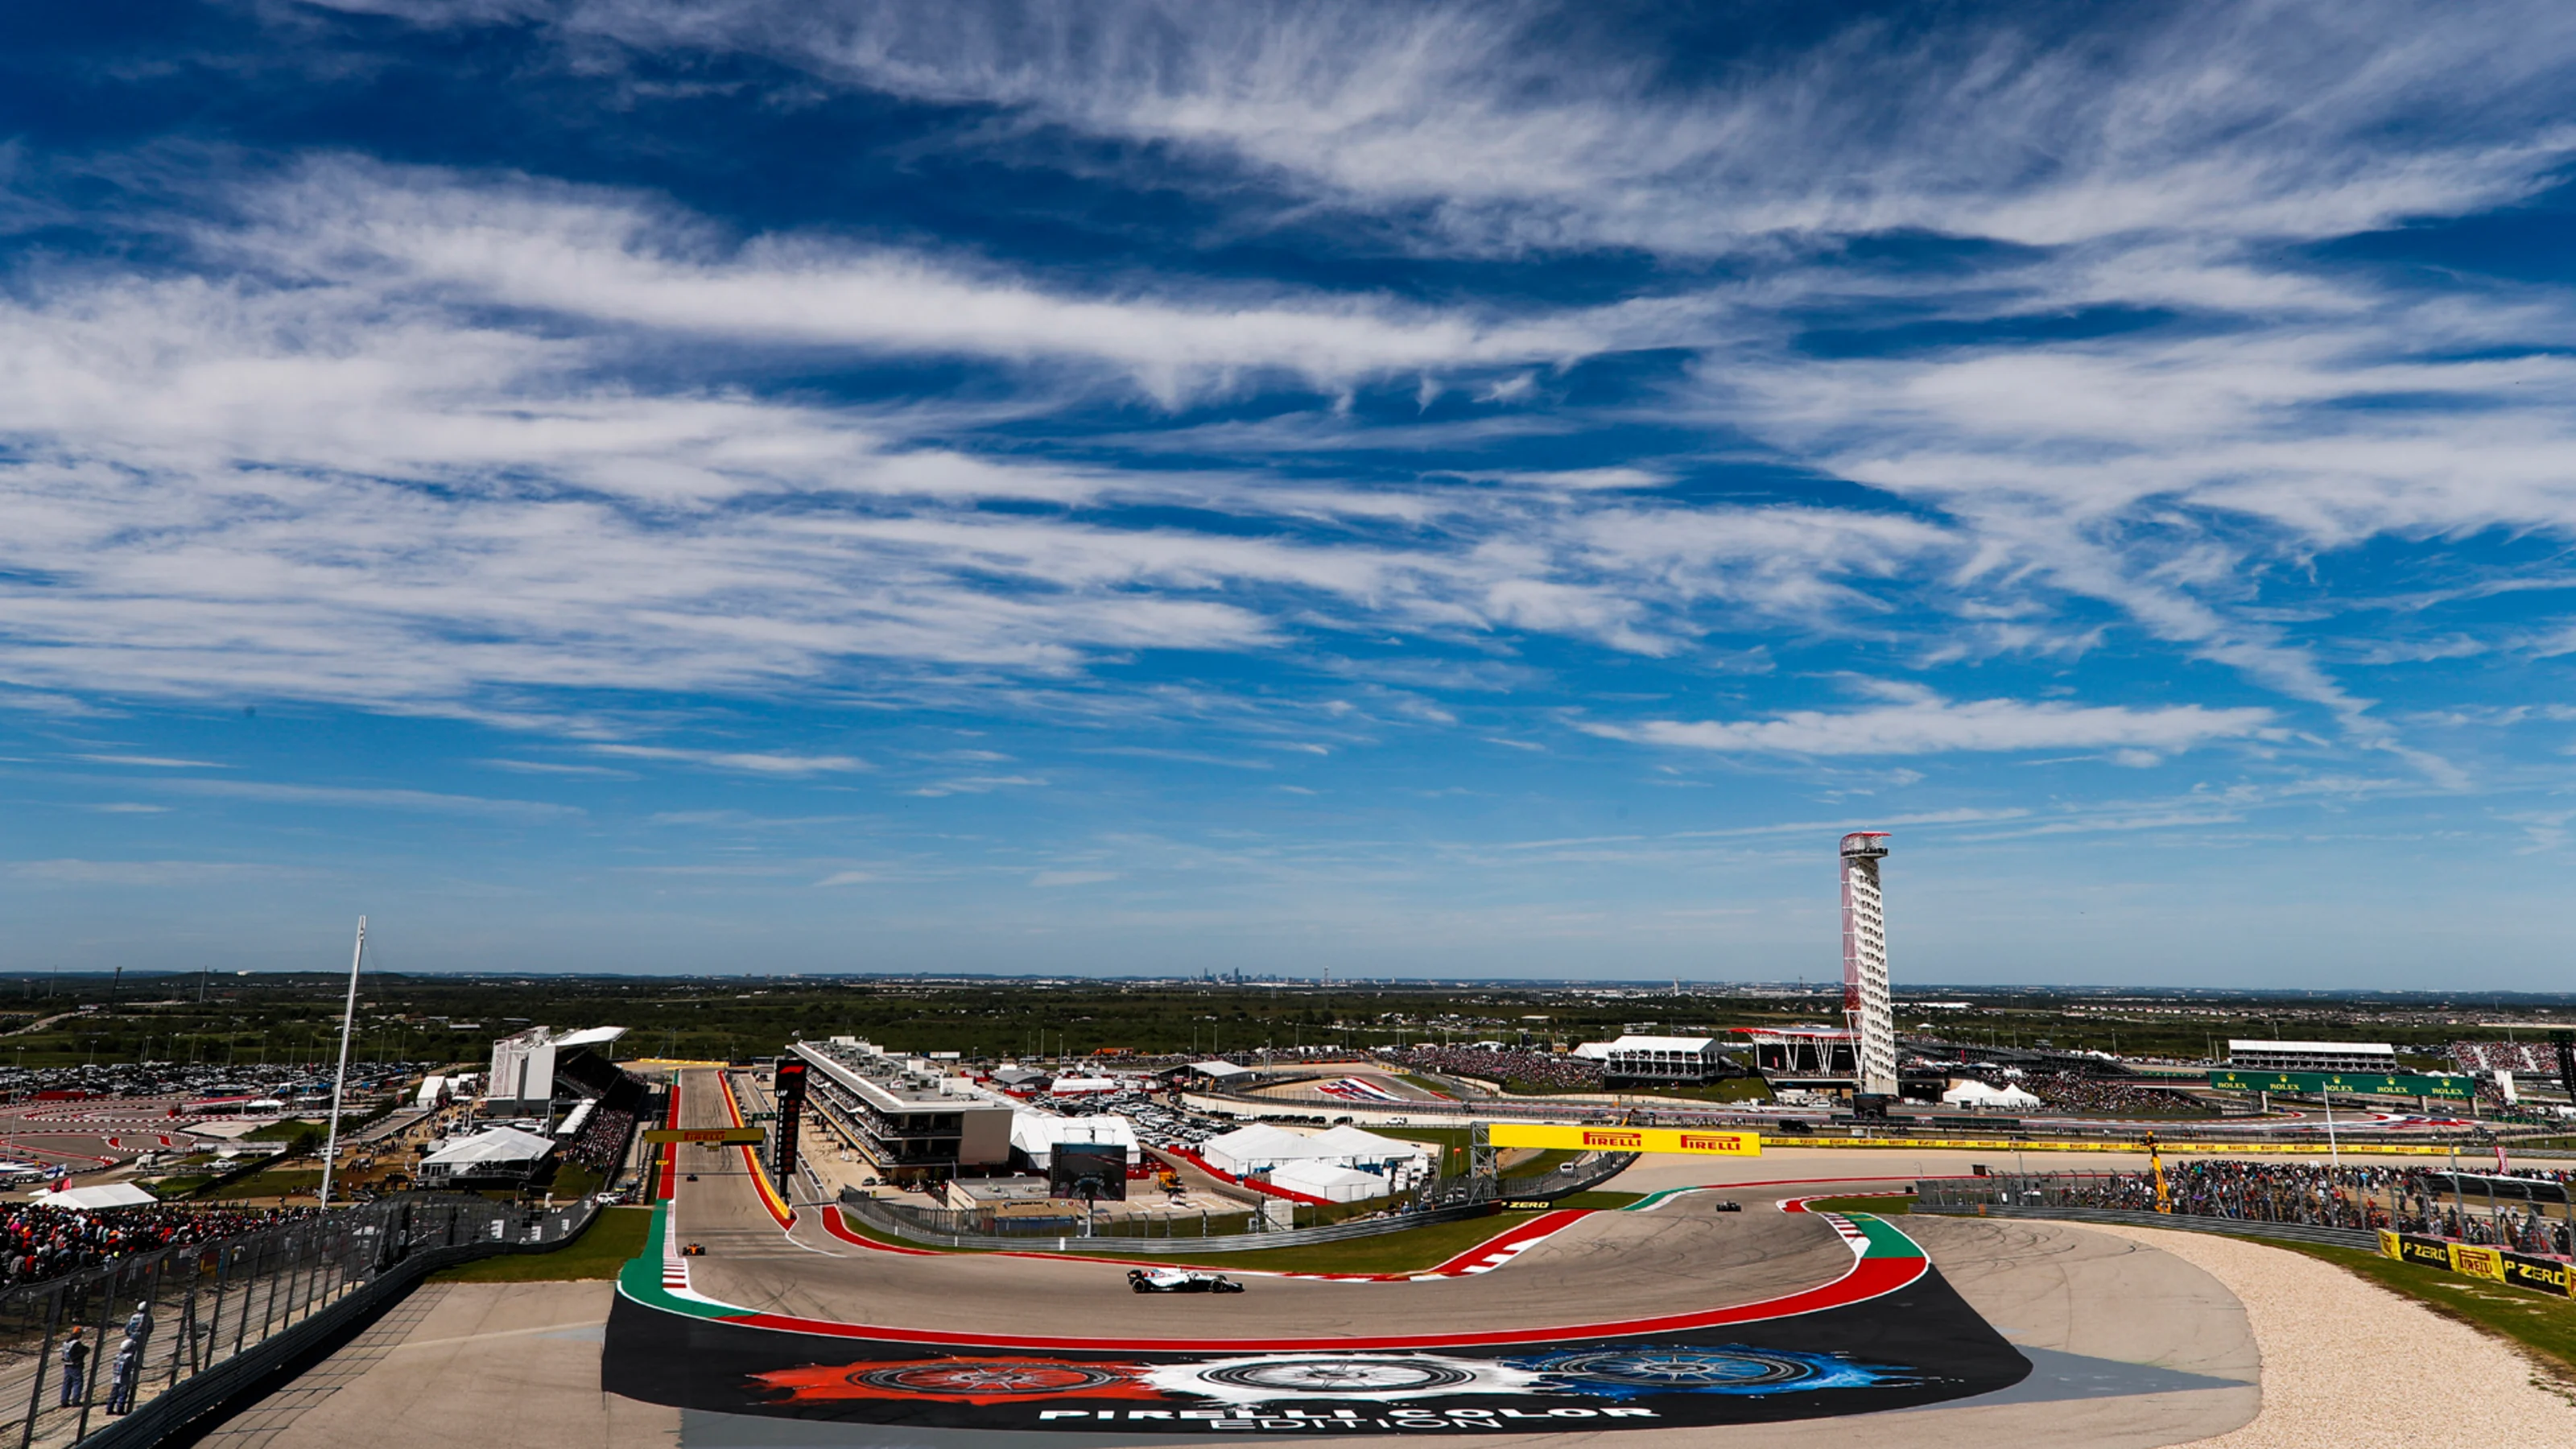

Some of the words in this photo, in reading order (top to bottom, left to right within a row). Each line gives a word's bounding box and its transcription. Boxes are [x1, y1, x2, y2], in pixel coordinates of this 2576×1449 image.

[1583, 1132, 1641, 1146] PIRELLI
[1681, 1135, 1740, 1150] PIRELLI
[2403, 1242, 2412, 1253] P
[2413, 1244, 2446, 1261] ZERO
[2458, 1249, 2492, 1274] PIRELLI
[2504, 1260, 2516, 1274] P
[2518, 1263, 2566, 1286] ZERO
[1039, 1410, 1358, 1420] PIRELLI
[1389, 1409, 1661, 1418] COLOR
[1210, 1418, 1503, 1430] EDITION
